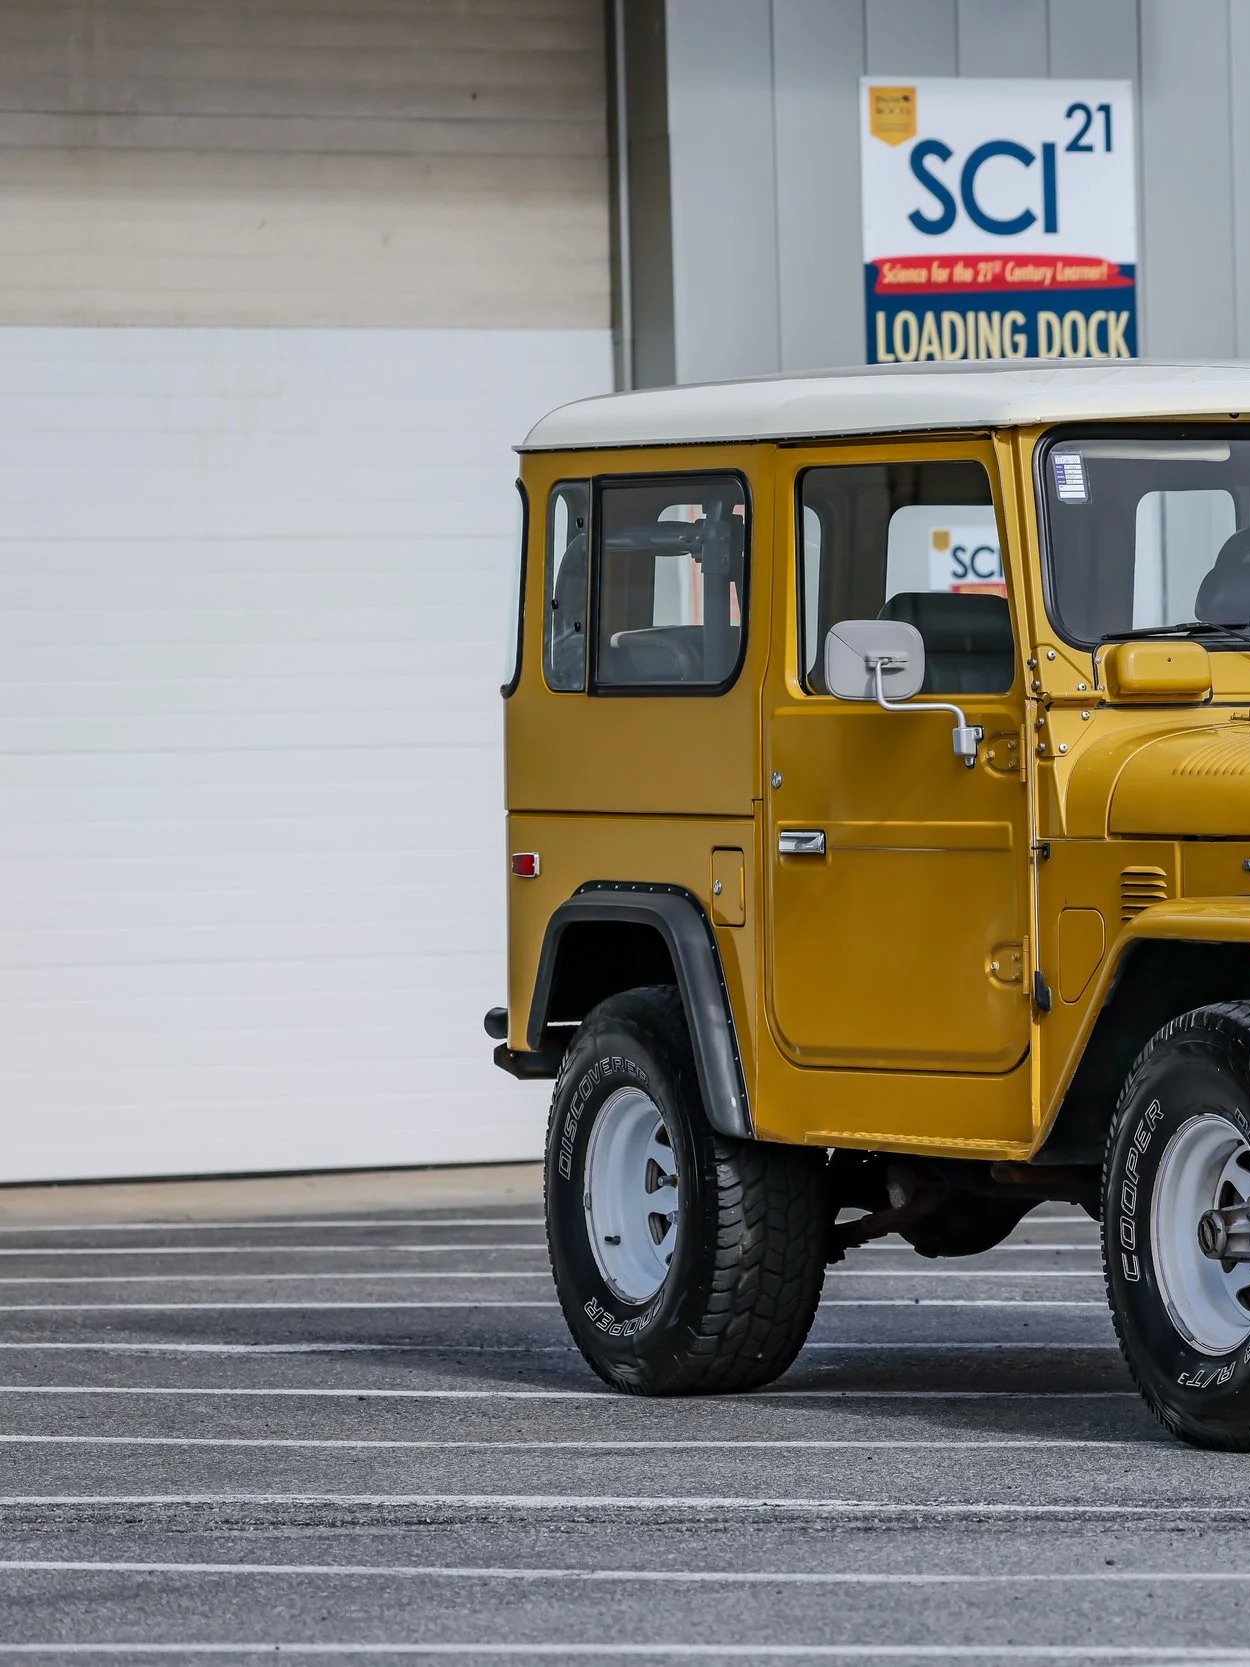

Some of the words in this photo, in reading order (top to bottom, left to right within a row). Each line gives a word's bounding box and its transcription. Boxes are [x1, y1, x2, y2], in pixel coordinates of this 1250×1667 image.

[908, 138, 1058, 235] SCI
[1064, 102, 1112, 152] 21
[875, 309, 1028, 362] LOADING
[1036, 309, 1131, 359] DOCK
[882, 262, 928, 284] Science
[931, 260, 950, 283] for
[953, 260, 974, 283] the
[1005, 261, 1054, 287] Century
[559, 1056, 650, 1181] DISCOVERER
[1120, 1098, 1166, 1283] COOPER
